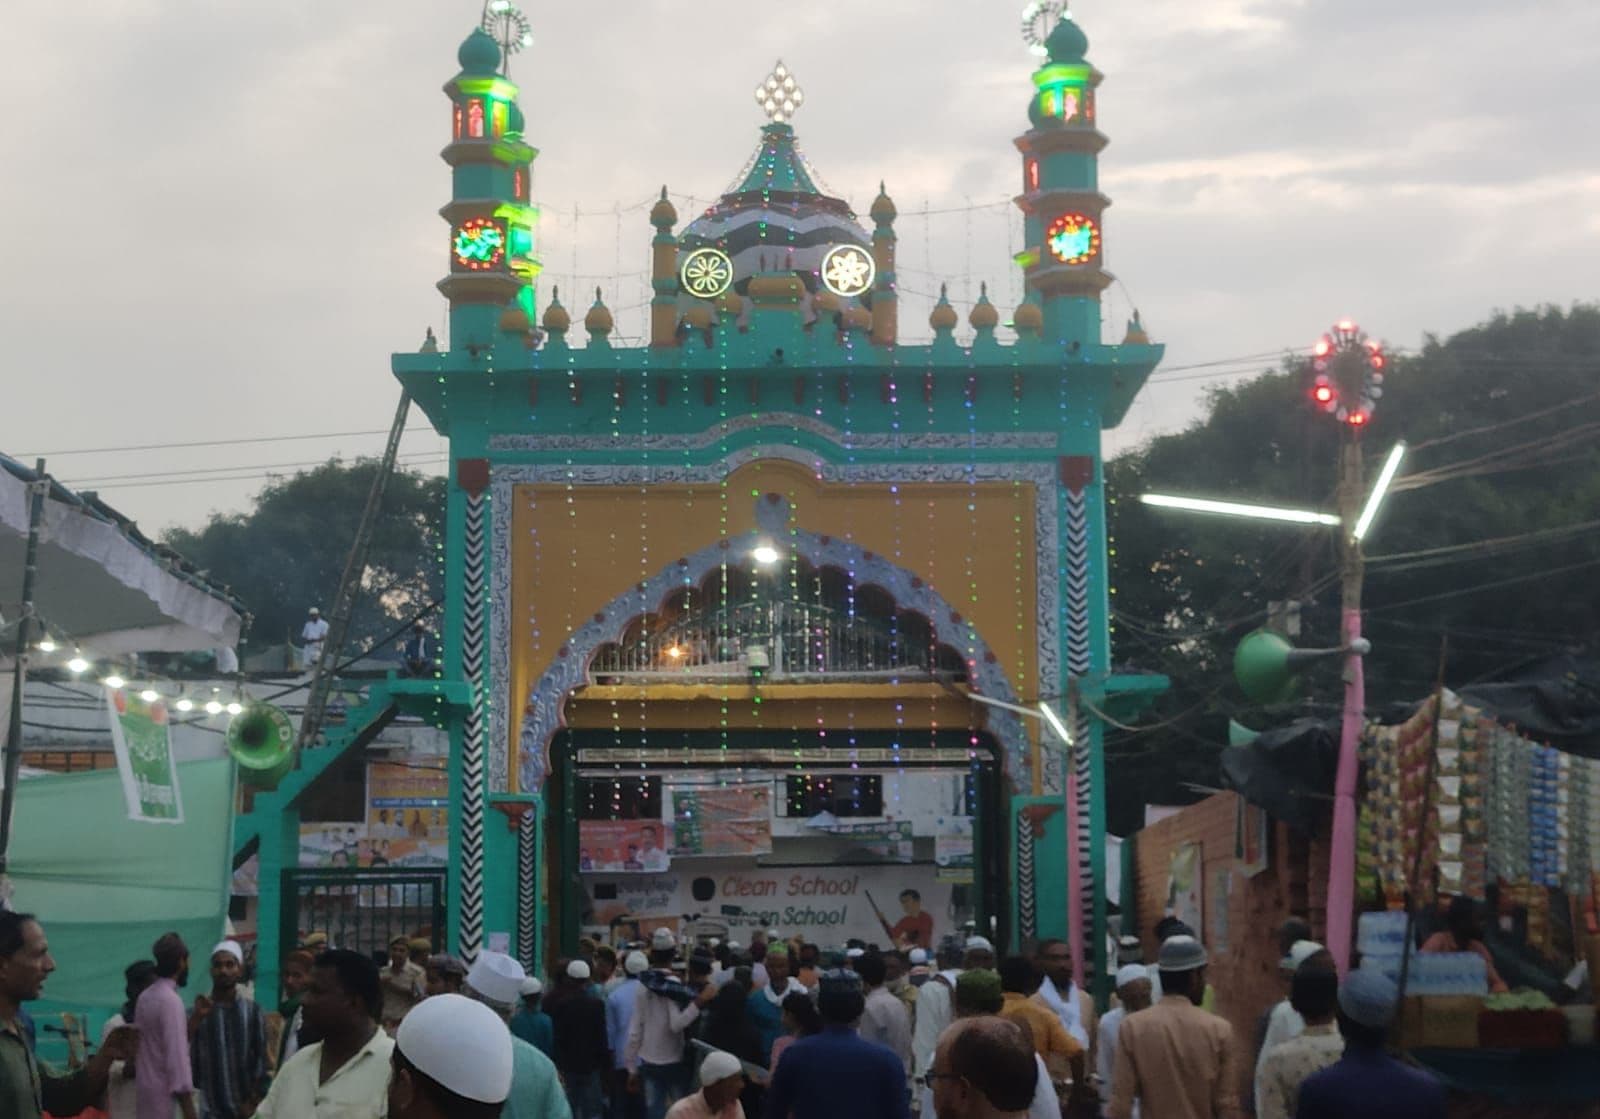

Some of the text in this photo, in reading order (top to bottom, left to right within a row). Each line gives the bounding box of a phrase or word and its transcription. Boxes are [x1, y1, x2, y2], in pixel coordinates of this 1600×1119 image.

[722, 875, 860, 897] Clean School
[783, 904, 848, 926] School
